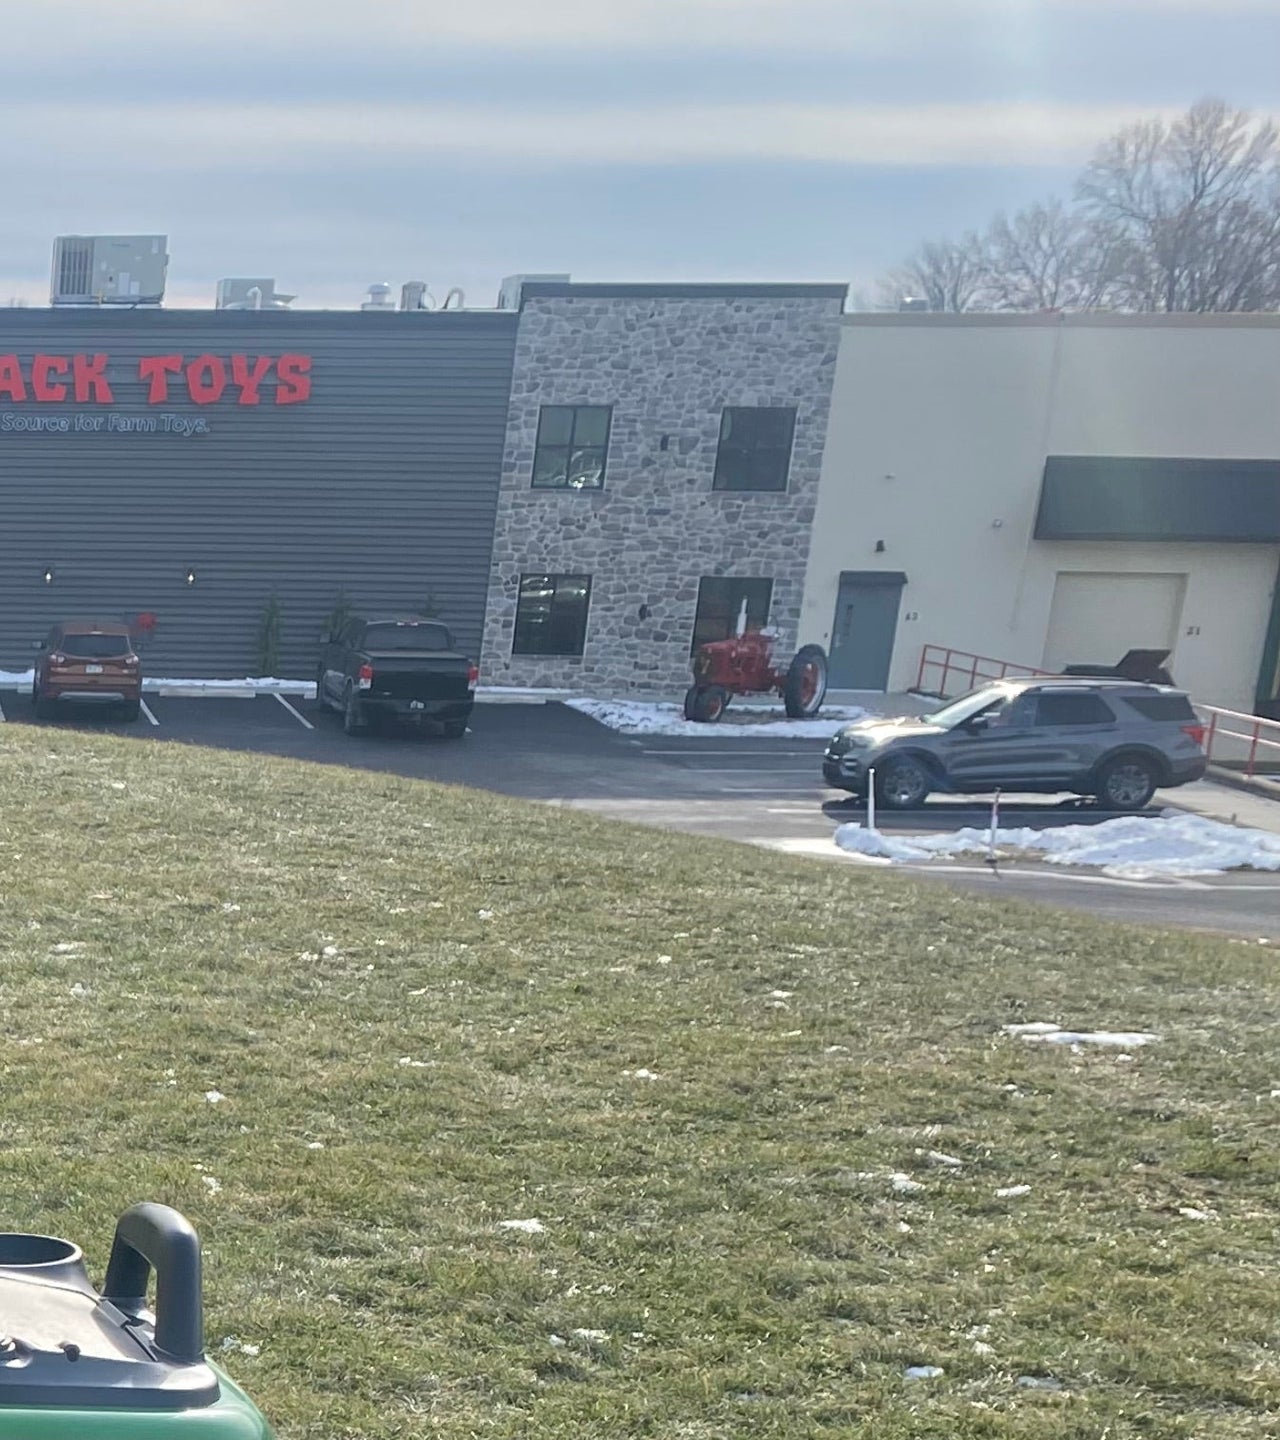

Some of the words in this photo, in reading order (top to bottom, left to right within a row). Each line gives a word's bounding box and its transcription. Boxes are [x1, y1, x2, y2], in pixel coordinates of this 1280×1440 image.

[138, 353, 313, 406] TOYS
[1, 412, 70, 432] Source
[74, 412, 103, 431] for
[107, 413, 157, 432] Farm
